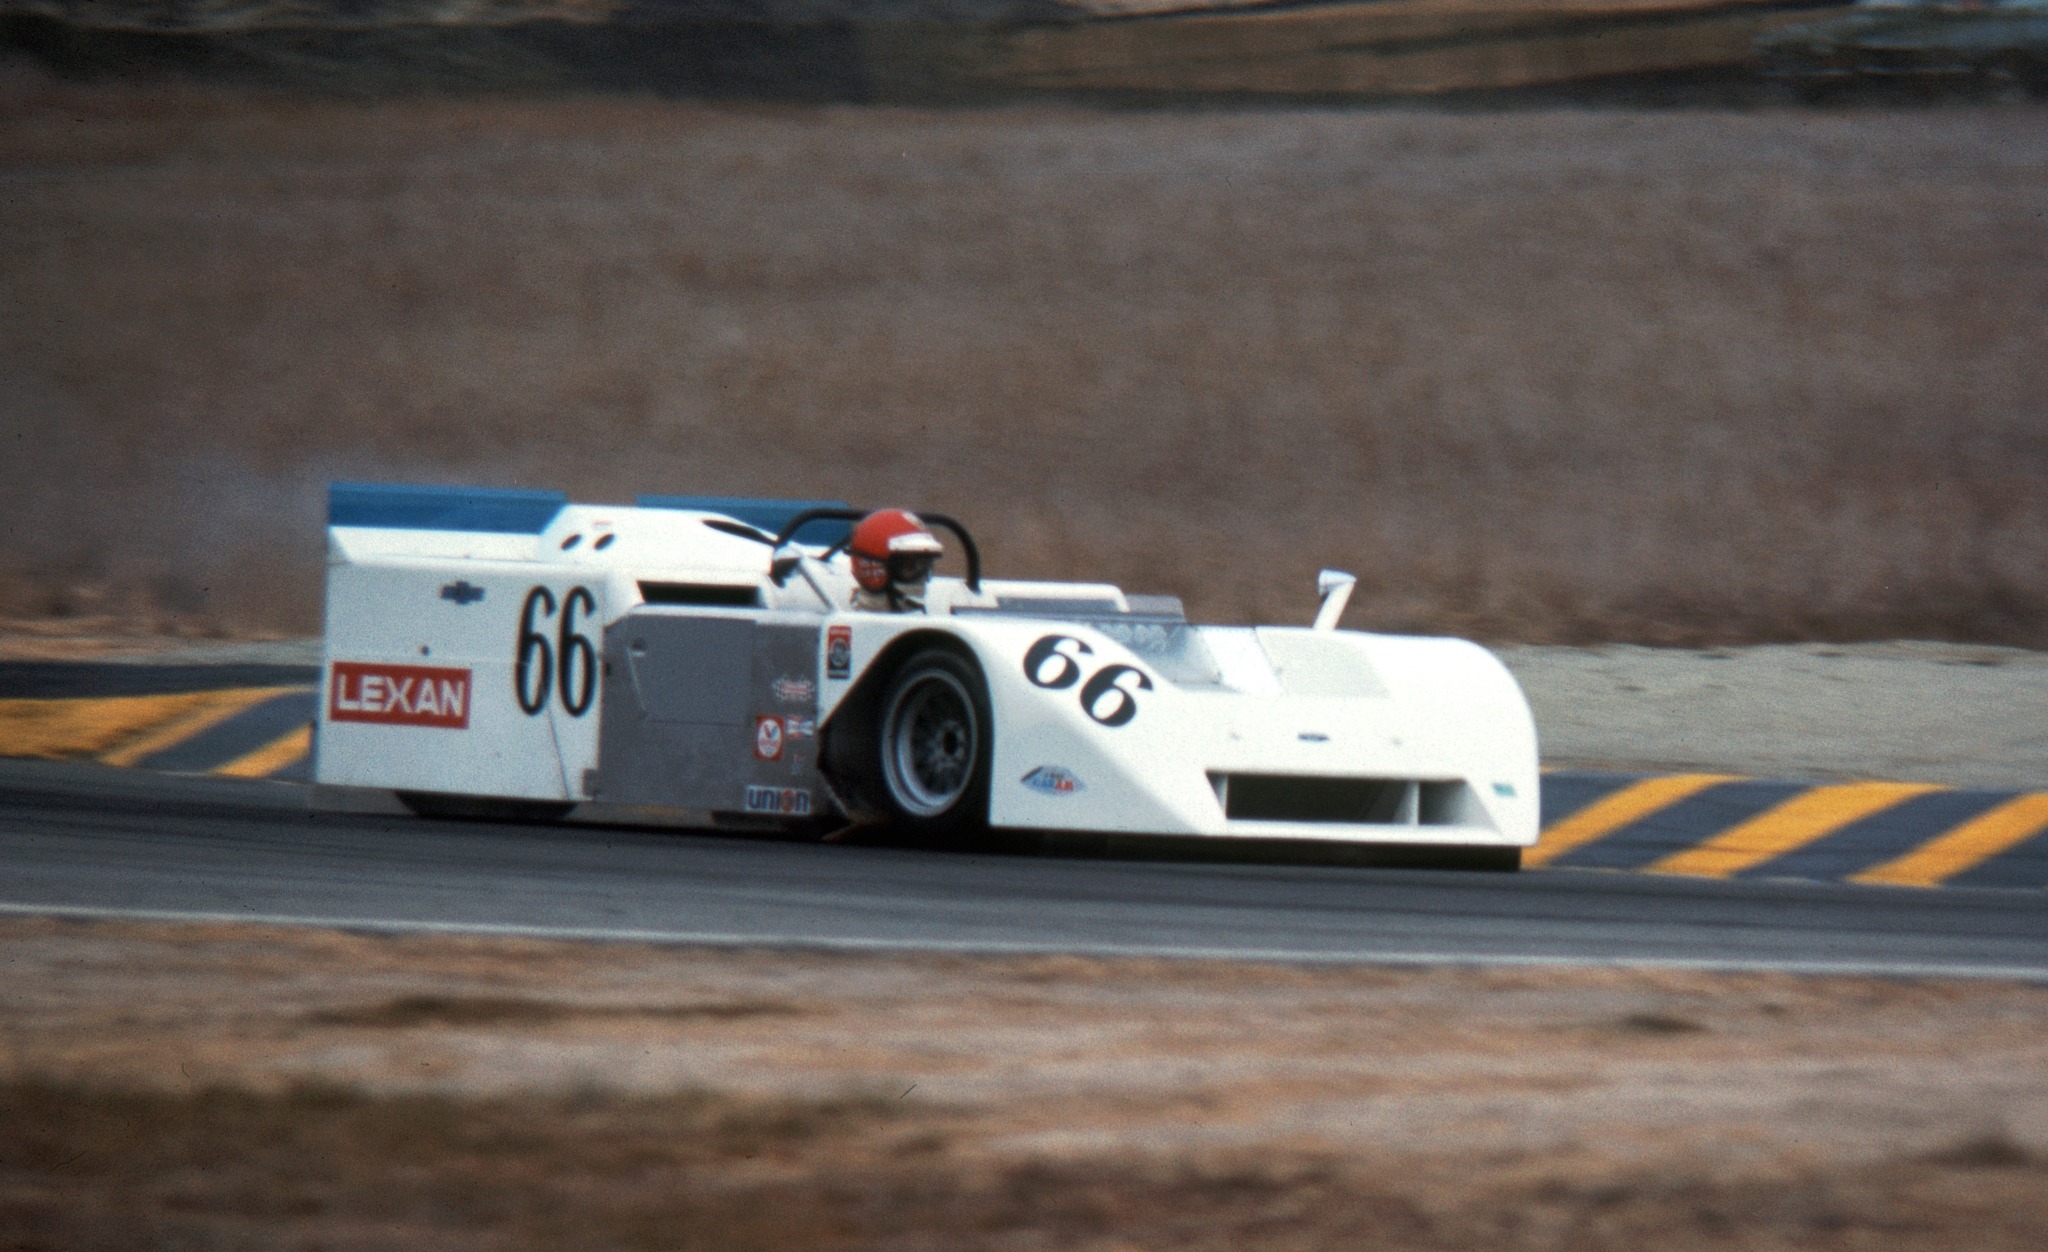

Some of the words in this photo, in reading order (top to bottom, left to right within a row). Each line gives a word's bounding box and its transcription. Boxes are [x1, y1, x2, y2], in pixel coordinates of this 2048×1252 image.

[338, 673, 465, 717] LEXAN
[515, 585, 597, 716] 66
[1022, 634, 1153, 727] 66
